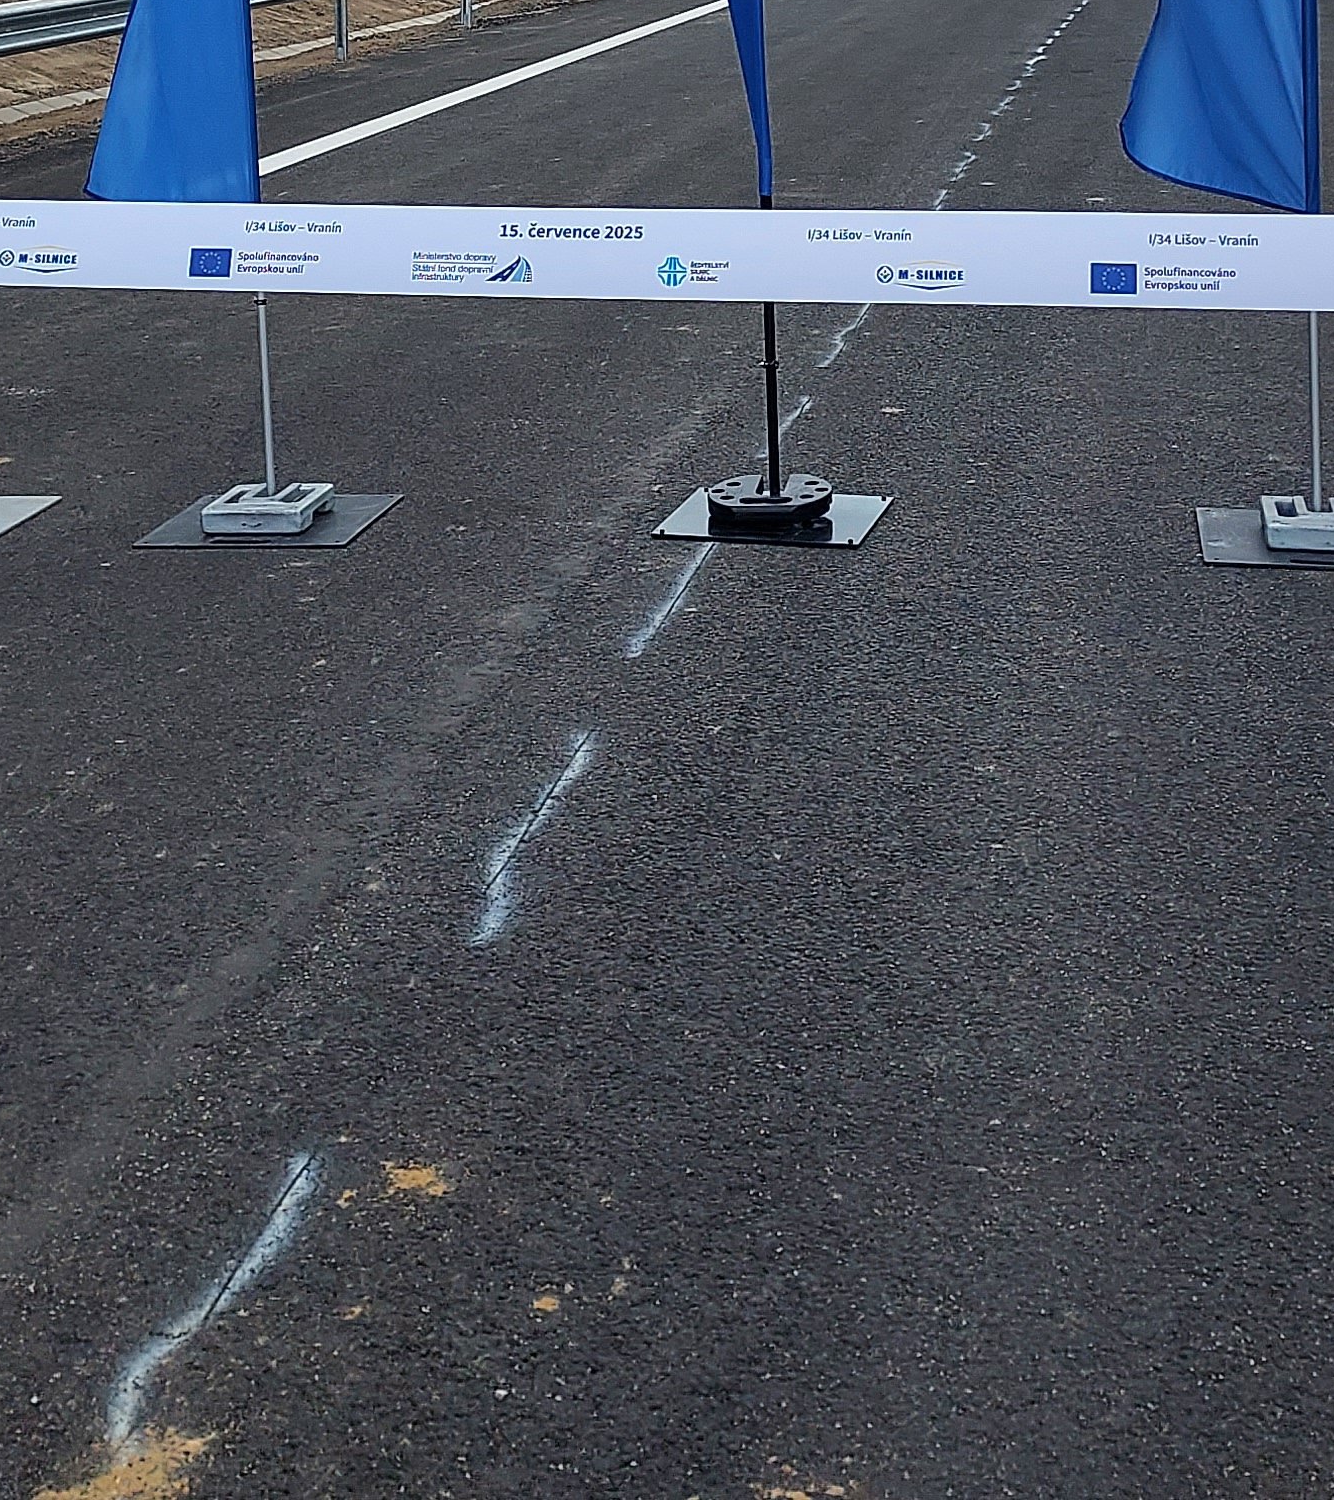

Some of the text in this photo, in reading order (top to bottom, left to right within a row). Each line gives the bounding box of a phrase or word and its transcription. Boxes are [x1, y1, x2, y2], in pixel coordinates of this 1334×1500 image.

[1, 216, 35, 227] Vranín
[245, 221, 265, 233] I/34
[268, 221, 296, 232] Lišov
[307, 222, 342, 233] Vranín
[499, 223, 643, 239] 15. července 2025
[808, 229, 829, 241] I/34
[832, 228, 862, 240] Lišov
[874, 229, 911, 241] Vranín
[1148, 234, 1171, 246] I/34
[1175, 234, 1206, 245] Lišov
[1218, 234, 1258, 246] Vranín
[237, 251, 319, 263] Spolufinancováno
[237, 264, 284, 274] Evropskou
[1144, 267, 1236, 279] Spolufinancováno
[1145, 280, 1219, 291] Evropskou unií
